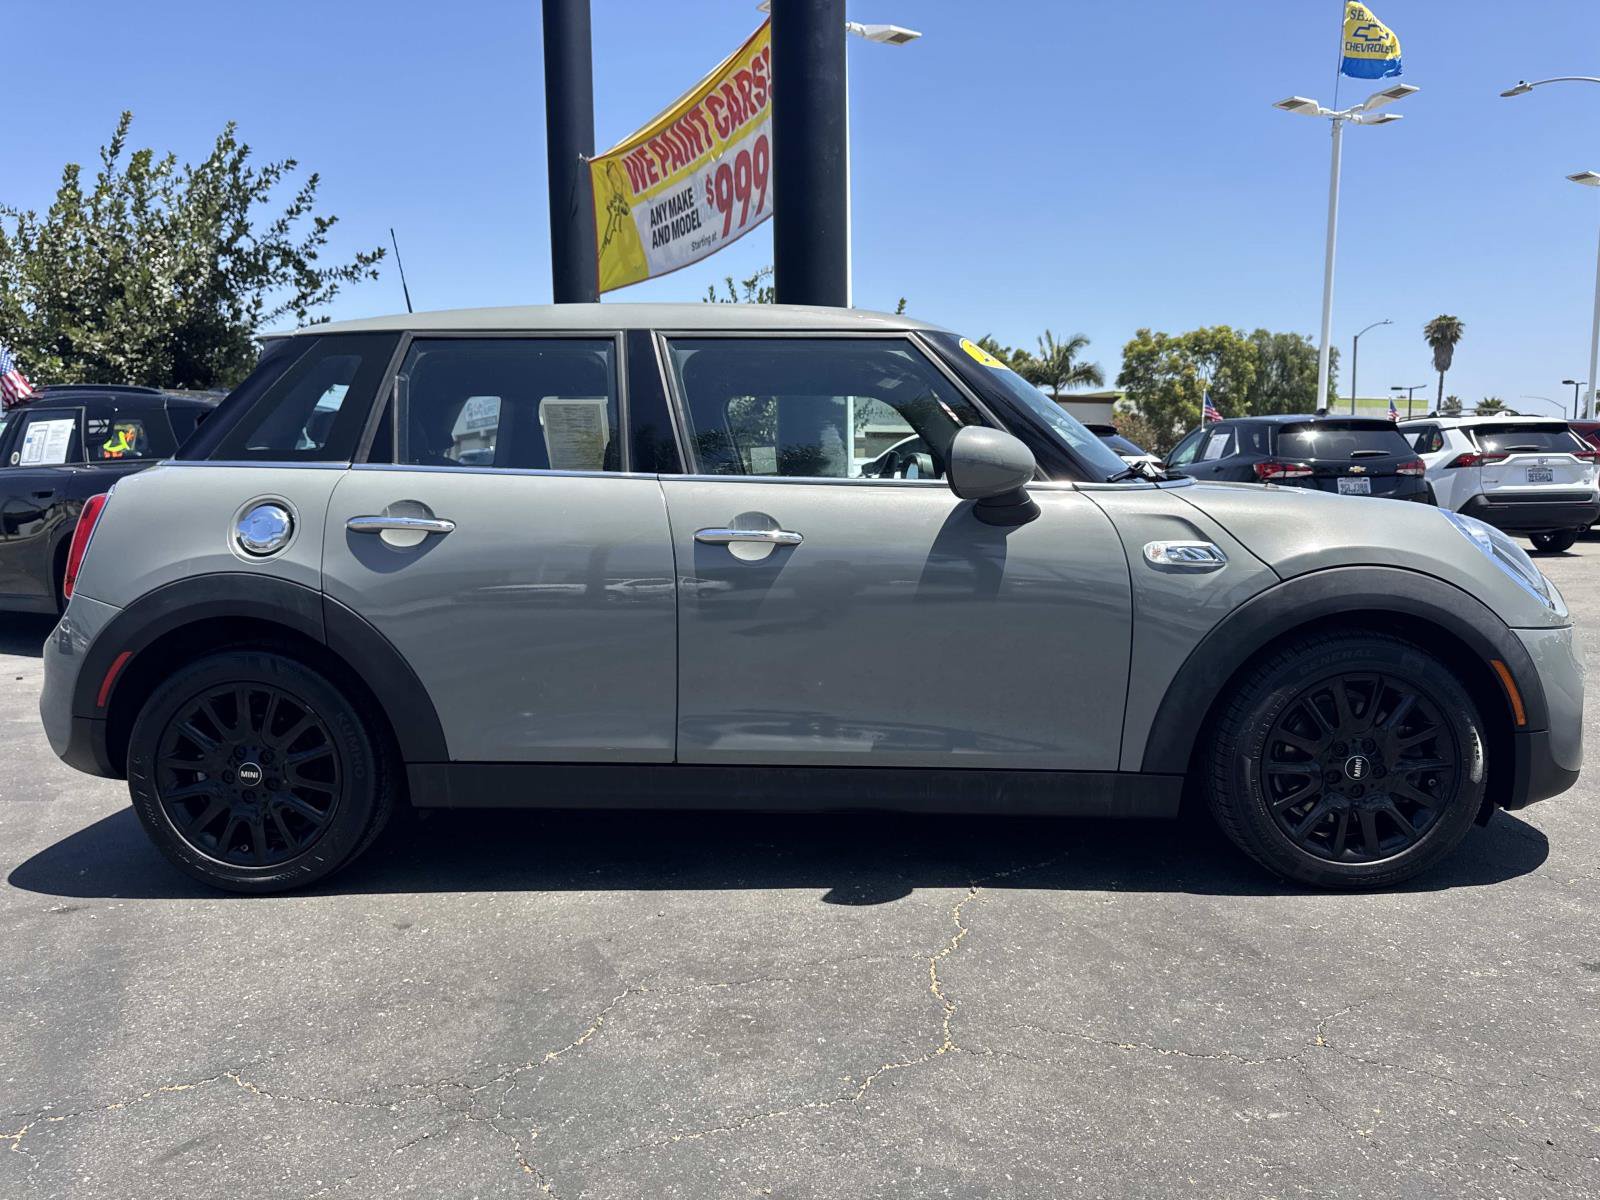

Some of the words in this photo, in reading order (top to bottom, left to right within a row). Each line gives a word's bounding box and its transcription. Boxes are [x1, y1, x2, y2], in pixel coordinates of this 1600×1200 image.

[1345, 41, 1395, 54] CHEVROLET
[621, 145, 660, 194] WE
[648, 104, 713, 178] PAINT
[705, 134, 769, 239] $999
[650, 201, 670, 228] ANY
[669, 187, 694, 217] MAKE
[652, 223, 673, 250] AND
[671, 208, 702, 240] MODEL
[691, 235, 711, 251] Starting
[240, 770, 259, 779] MINI
[1353, 758, 1363, 777] MINI
